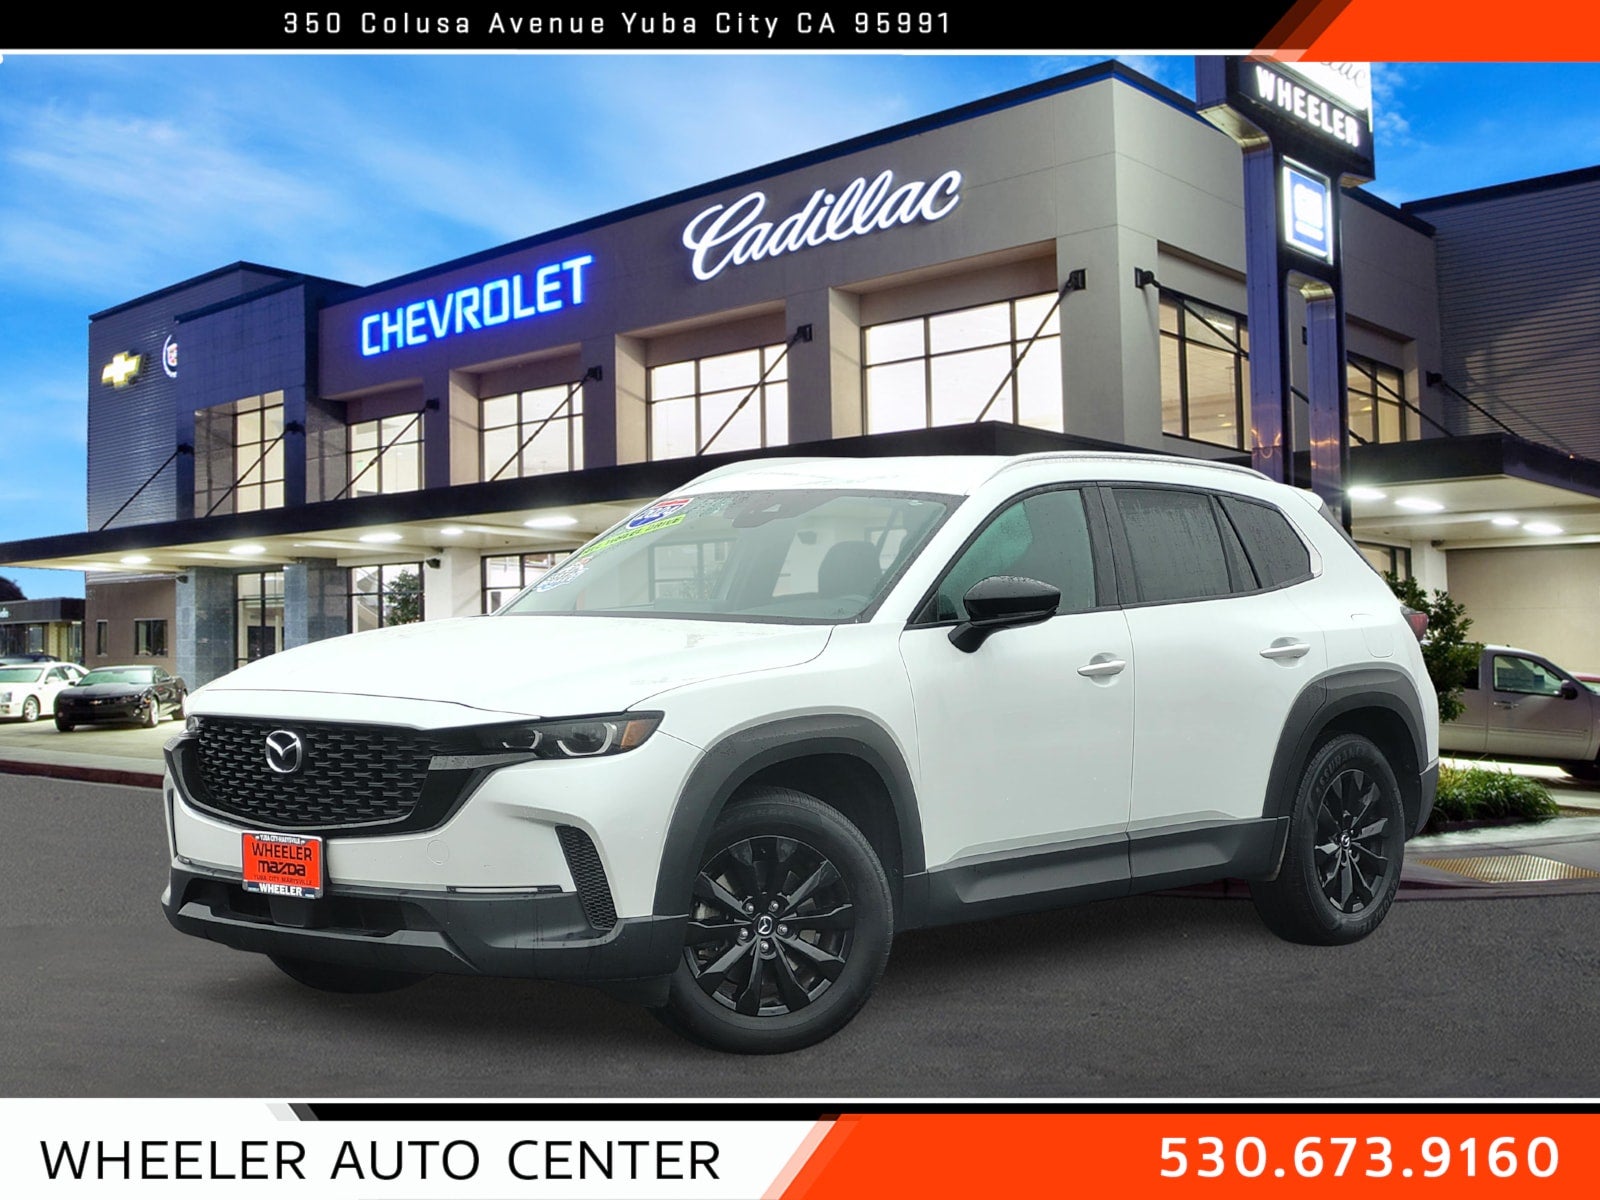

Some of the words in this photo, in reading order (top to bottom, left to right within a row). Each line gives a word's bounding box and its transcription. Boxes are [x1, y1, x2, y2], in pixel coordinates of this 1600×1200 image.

[1255, 65, 1360, 147] WHEELER
[682, 168, 961, 281] Cadillac
[361, 254, 593, 357] CHEVROLET
[251, 841, 312, 862] WHEELER
[258, 882, 303, 897] WHEELER
